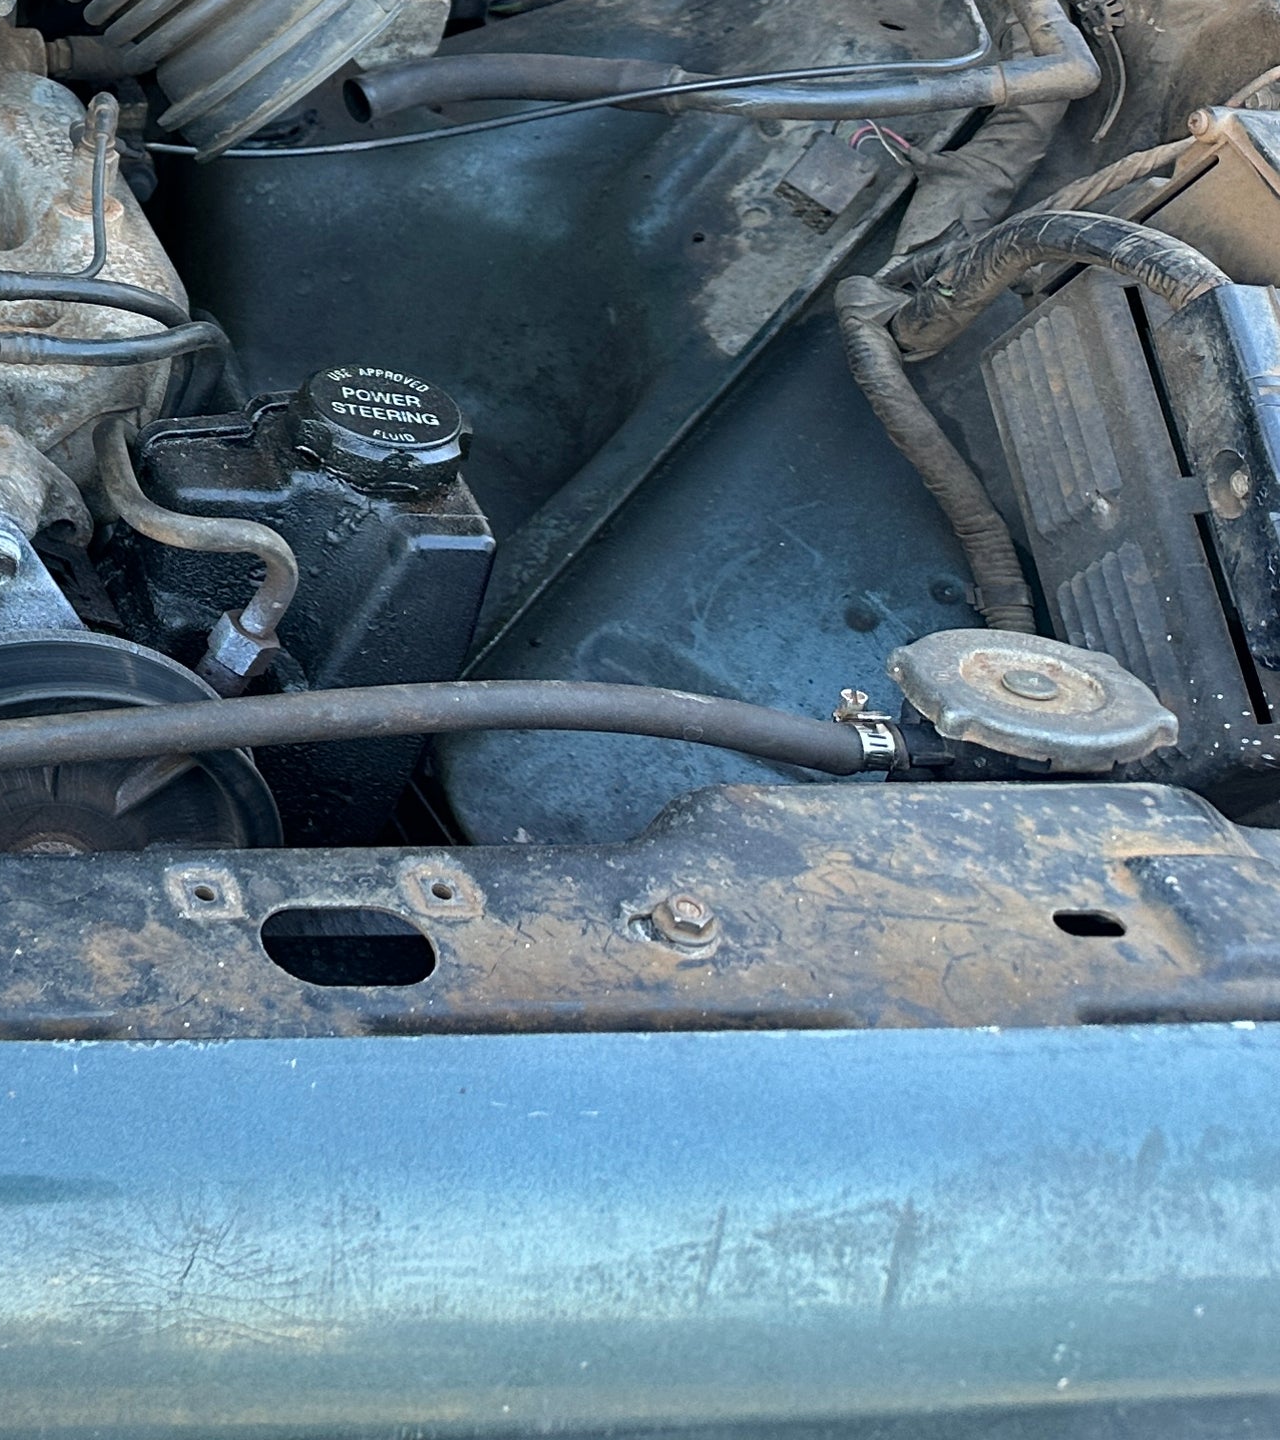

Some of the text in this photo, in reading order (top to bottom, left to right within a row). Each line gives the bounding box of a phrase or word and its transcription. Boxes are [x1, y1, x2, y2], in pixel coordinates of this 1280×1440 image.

[327, 367, 430, 393] USE APPROVED
[341, 386, 422, 408] POWER
[331, 402, 441, 426] STEERING
[372, 429, 416, 442] FLUID
